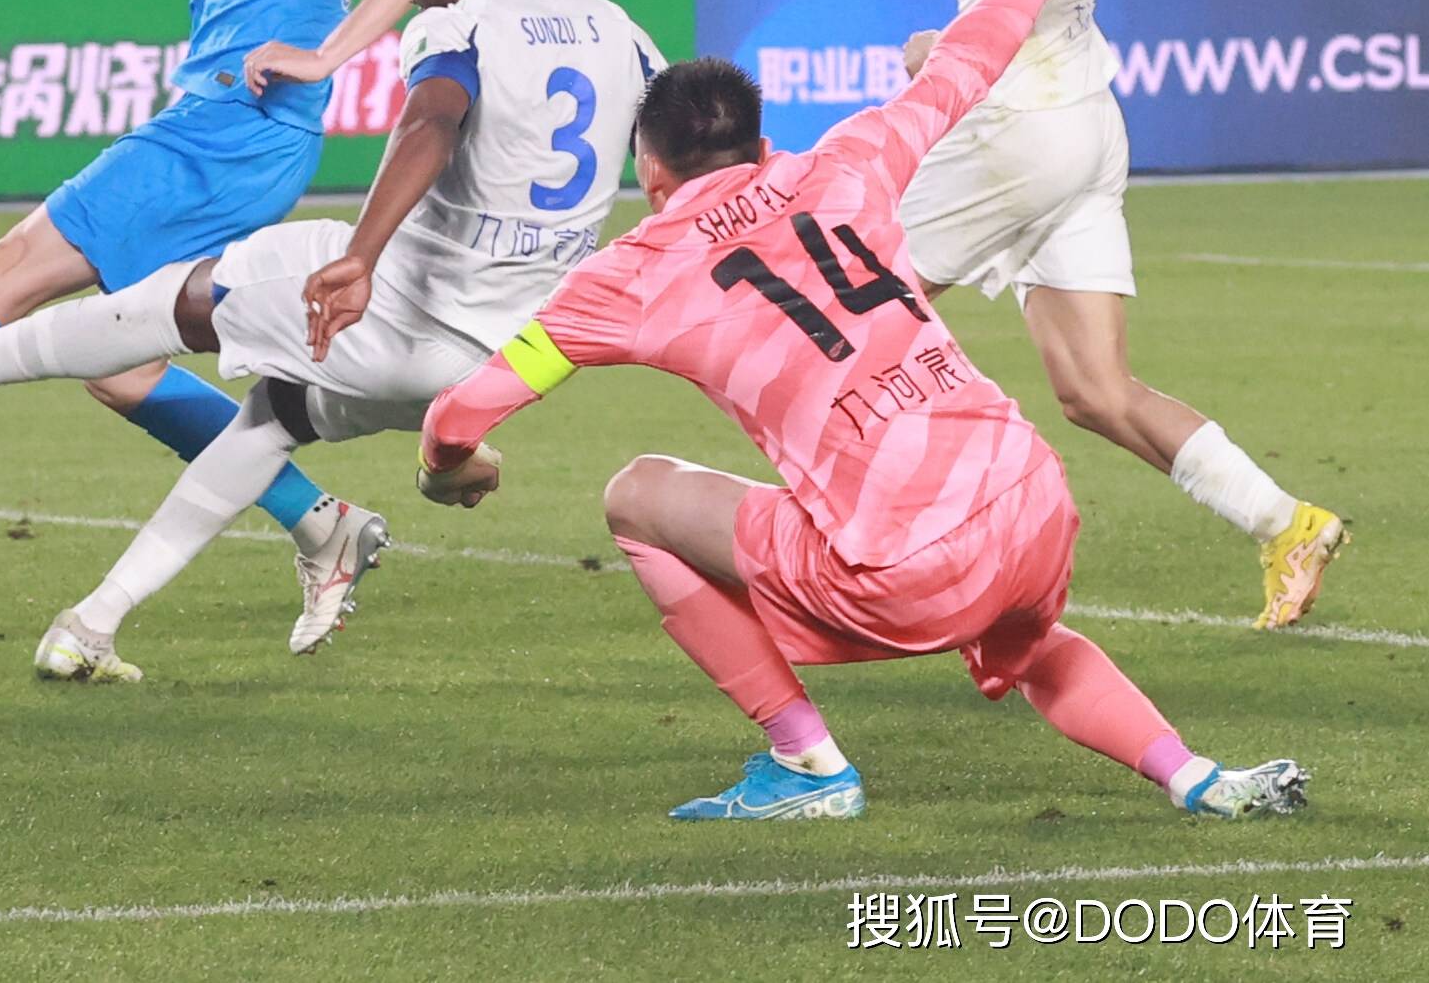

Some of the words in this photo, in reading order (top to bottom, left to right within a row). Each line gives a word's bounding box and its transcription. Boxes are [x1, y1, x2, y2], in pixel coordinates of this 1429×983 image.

[587, 15, 600, 44] S
[529, 65, 598, 212] 3
[694, 194, 758, 245] SHAO
[710, 210, 932, 363] 14
